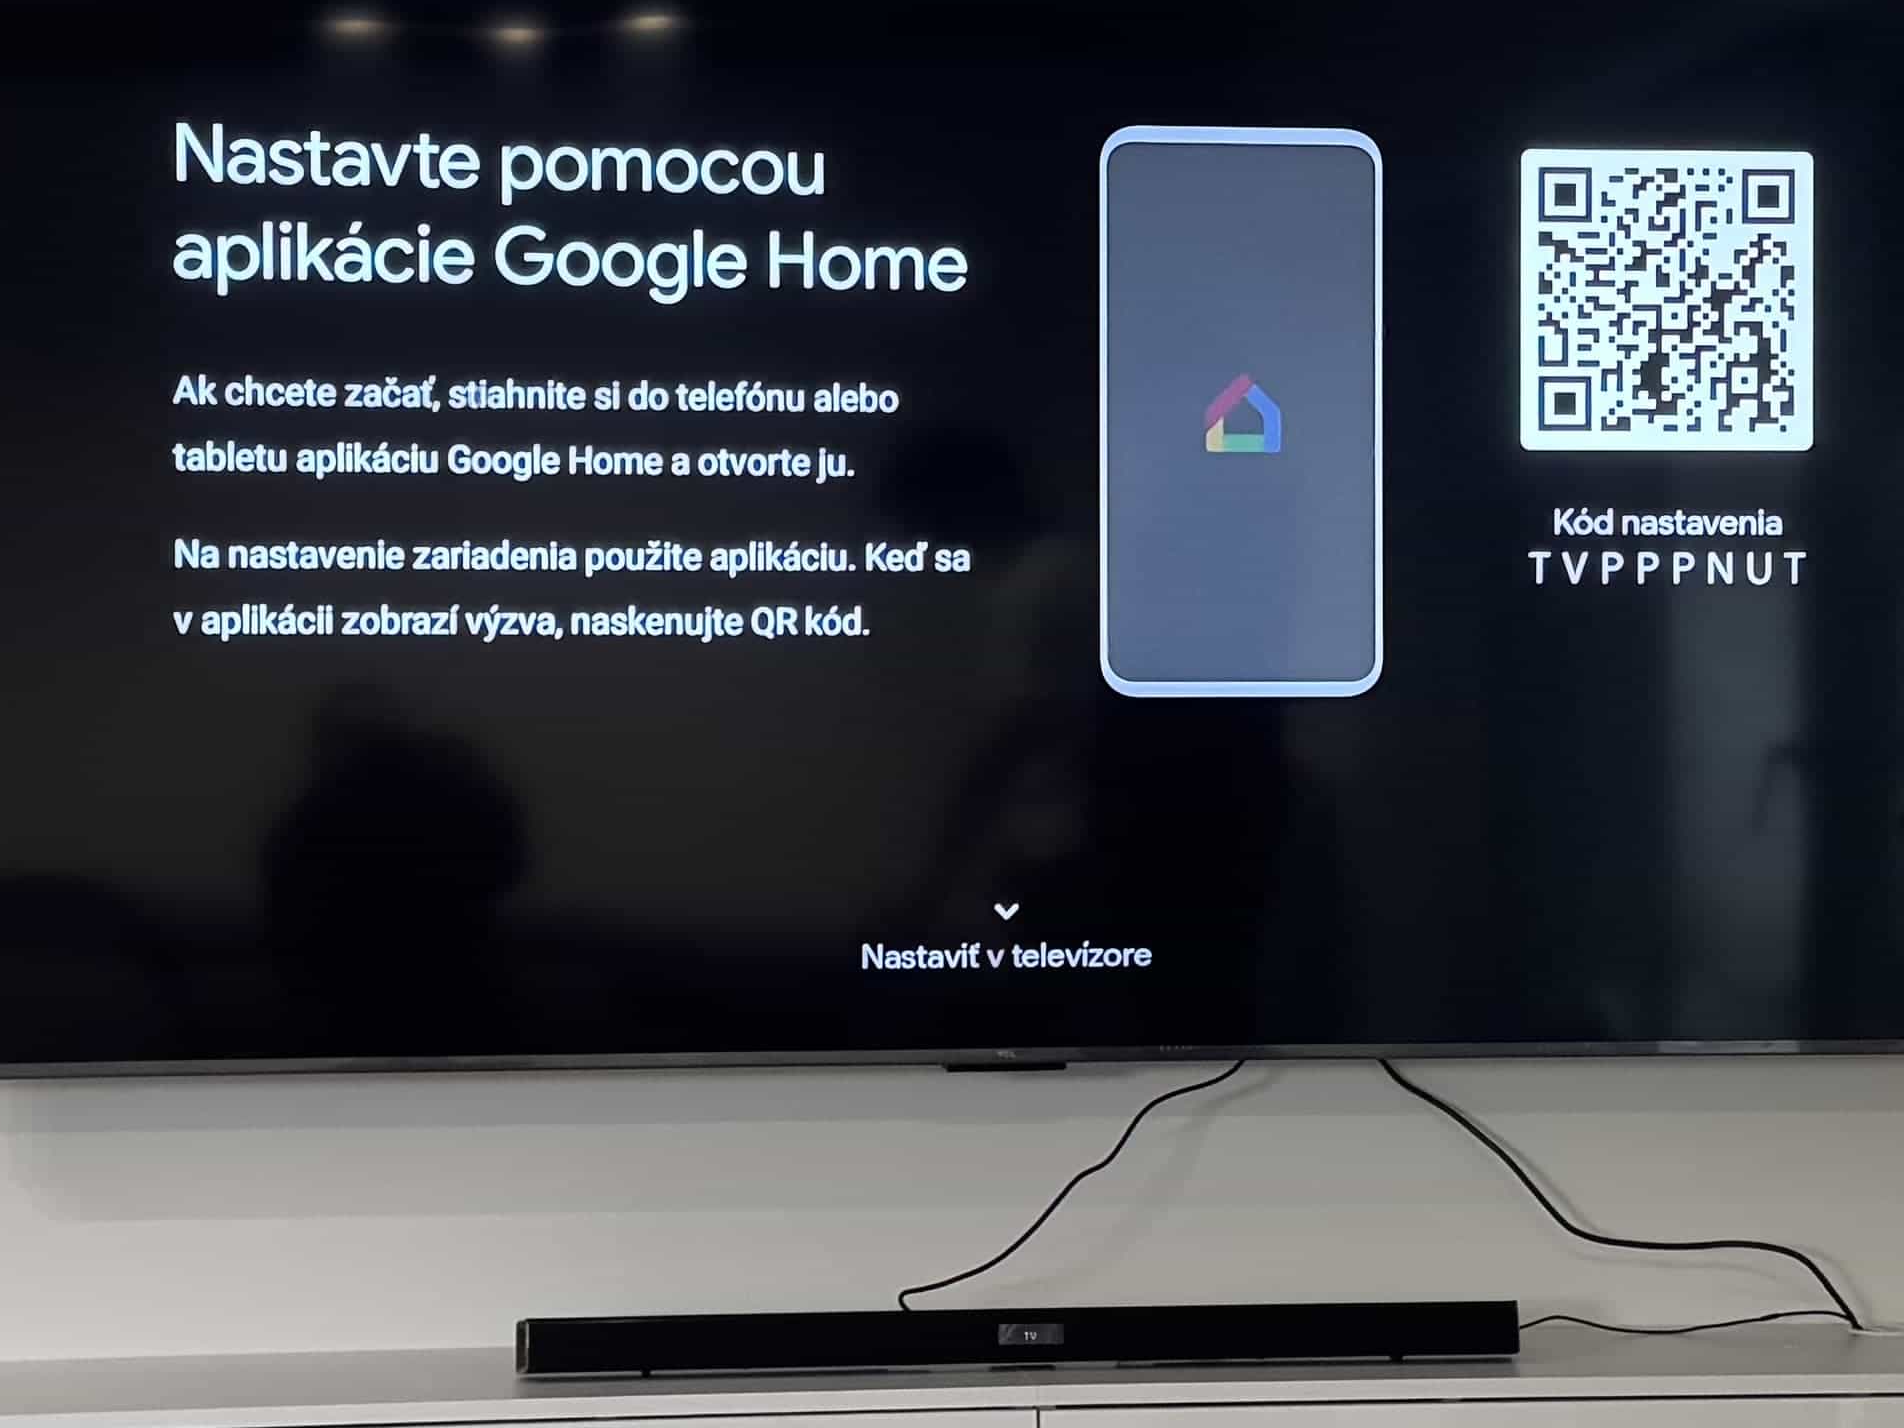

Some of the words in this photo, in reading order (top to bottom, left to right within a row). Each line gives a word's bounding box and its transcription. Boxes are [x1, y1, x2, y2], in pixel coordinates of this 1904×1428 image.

[175, 122, 481, 190] Nastavte
[501, 144, 825, 206] pomocou
[172, 220, 476, 297] aplikácie
[494, 224, 748, 305] Google
[768, 229, 969, 292] Home
[172, 373, 219, 406] Ak
[224, 374, 338, 408] chcete
[343, 374, 441, 413] začať,
[447, 377, 587, 411] stiahnite
[593, 379, 621, 411] si
[627, 379, 670, 412] do
[674, 379, 806, 413] telefónu
[813, 381, 900, 414] alebo
[171, 439, 288, 473] tabletu
[295, 441, 439, 481] aplikáciu
[447, 443, 561, 482] Google
[568, 444, 665, 477] Home
[670, 452, 691, 477] a
[697, 448, 812, 478] otvorte
[815, 447, 855, 485] ju.
[1553, 506, 1615, 536] Kód
[1621, 508, 1784, 537] nastavenia
[174, 537, 221, 569] Na
[227, 538, 406, 570] nastavenie
[411, 538, 578, 571] zariadenia
[584, 539, 704, 578] použite
[709, 540, 857, 579] aplikáciu.
[865, 540, 929, 573] Keď
[934, 548, 971, 573] sa
[1527, 550, 1807, 586] TVPPPNUT
[172, 611, 194, 635] v
[200, 603, 334, 643] aplikácii
[340, 603, 461, 636] zobrazí
[464, 603, 564, 644] výzva,
[570, 604, 745, 644] naskenujte
[750, 605, 799, 640] QR
[804, 604, 871, 637] kód.
[861, 942, 981, 970] Nastaviť
[986, 948, 1005, 969] v
[1011, 940, 1153, 969] televízore
